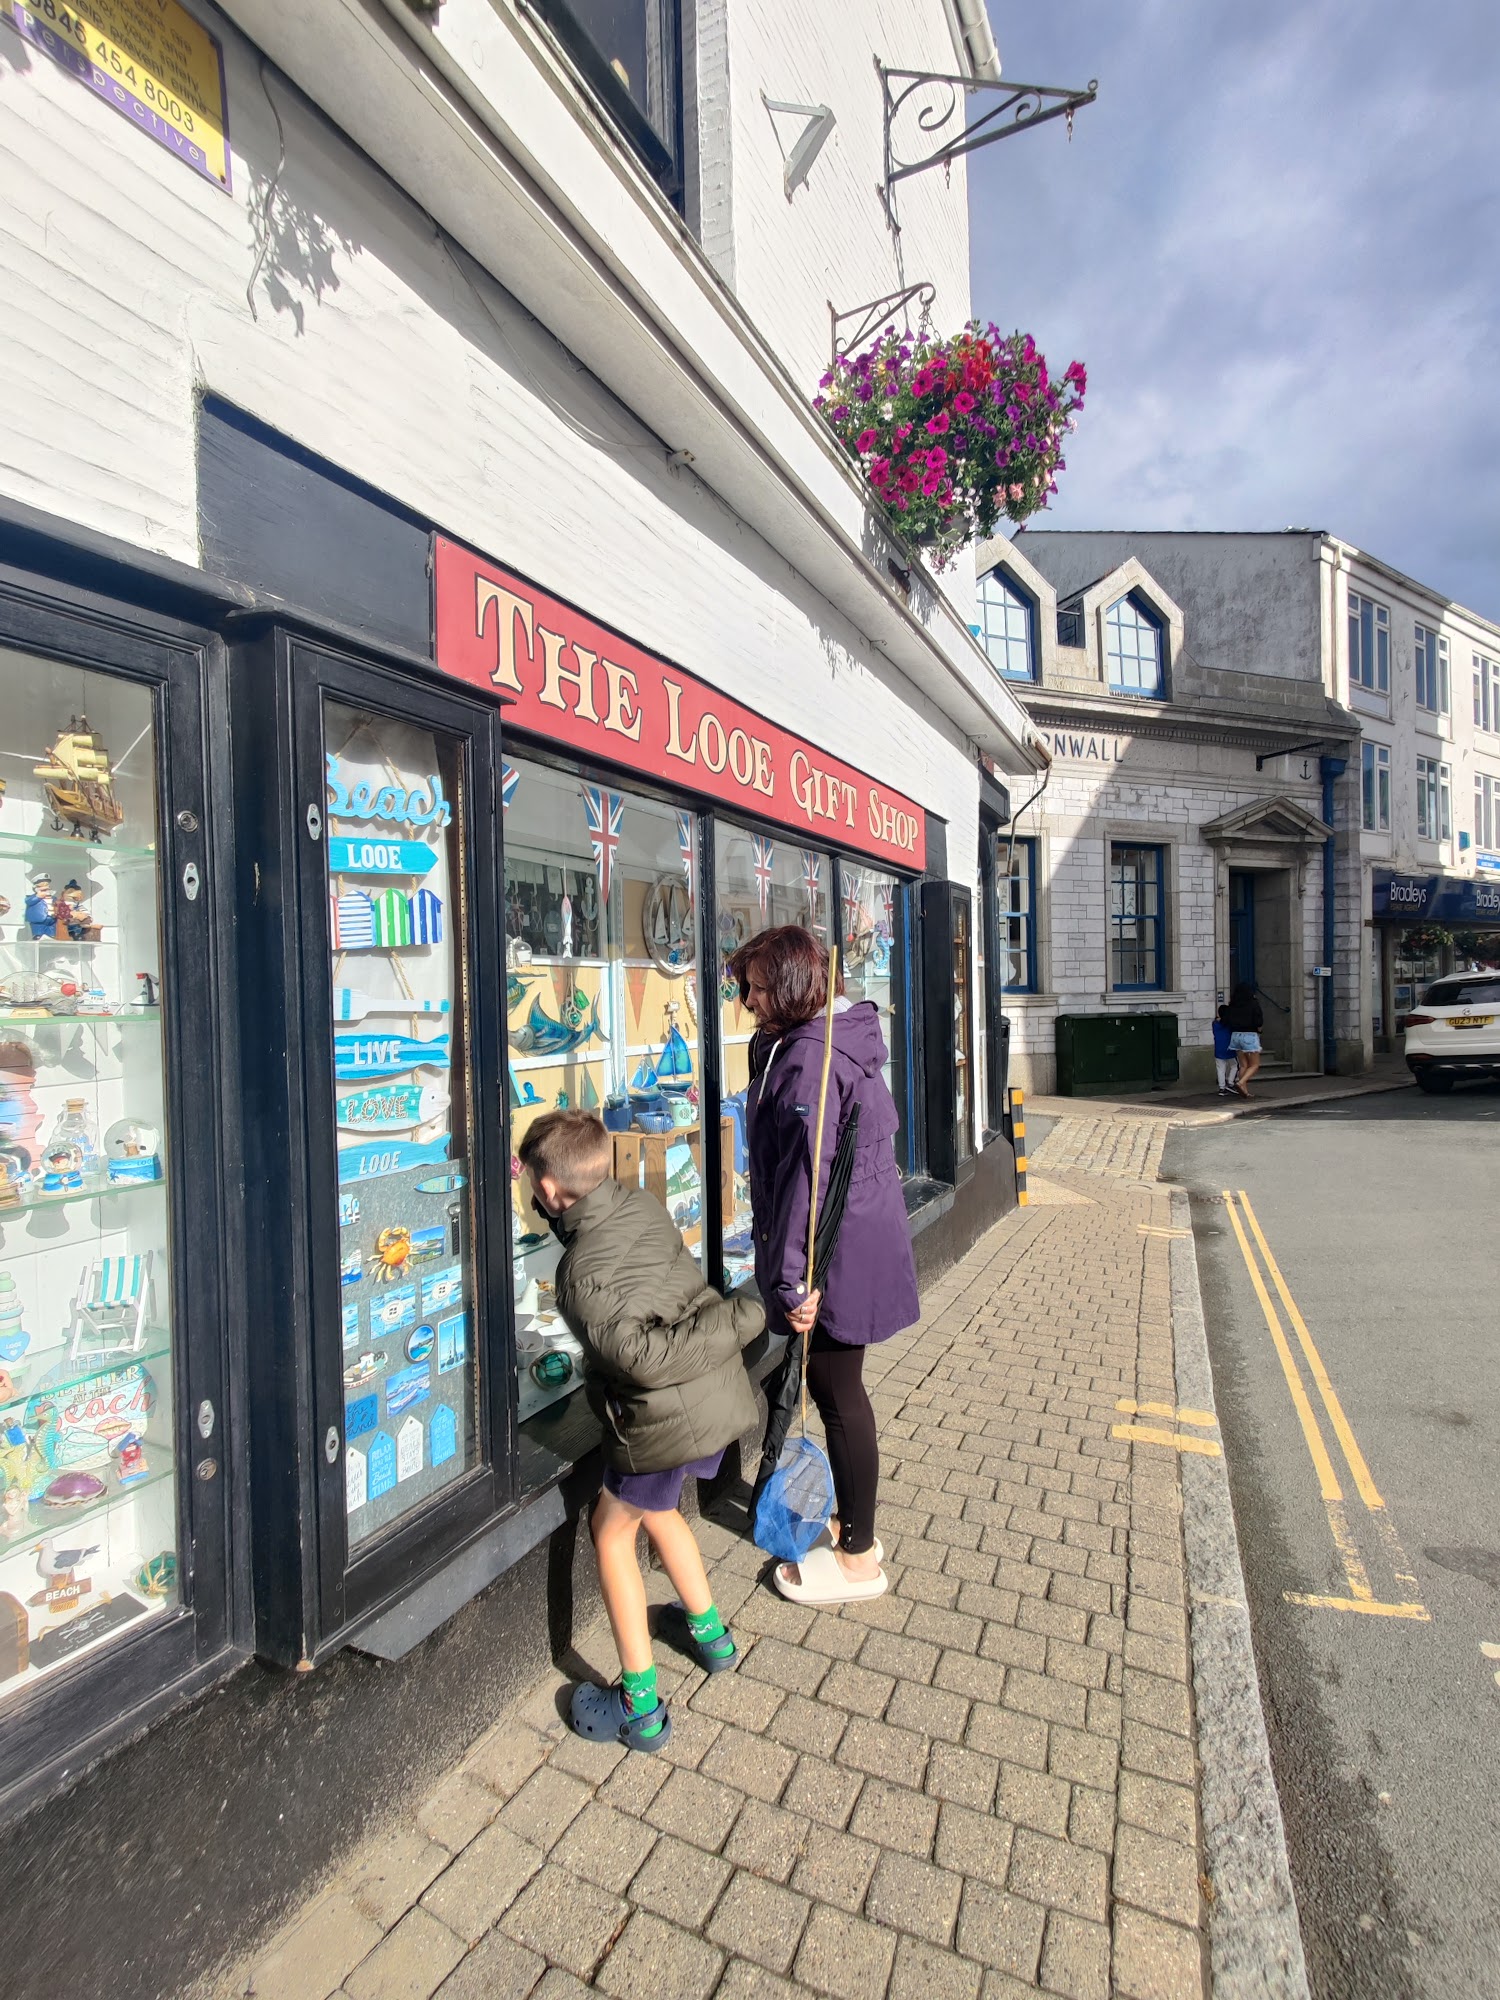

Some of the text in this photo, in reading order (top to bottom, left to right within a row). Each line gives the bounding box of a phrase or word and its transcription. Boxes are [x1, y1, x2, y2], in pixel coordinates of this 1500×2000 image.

[95, 41, 137, 88] 454
[144, 78, 195, 133] 8003
[474, 572, 920, 853] THE LOOE GIFT SHOP
[346, 843, 403, 870] LOOE
[1390, 881, 1427, 908] Bradleys
[354, 1040, 401, 1065] LIVE
[346, 1095, 409, 1124] LOVE
[358, 1151, 402, 1175] LOOE
[45, 1585, 80, 1601] BEACH
